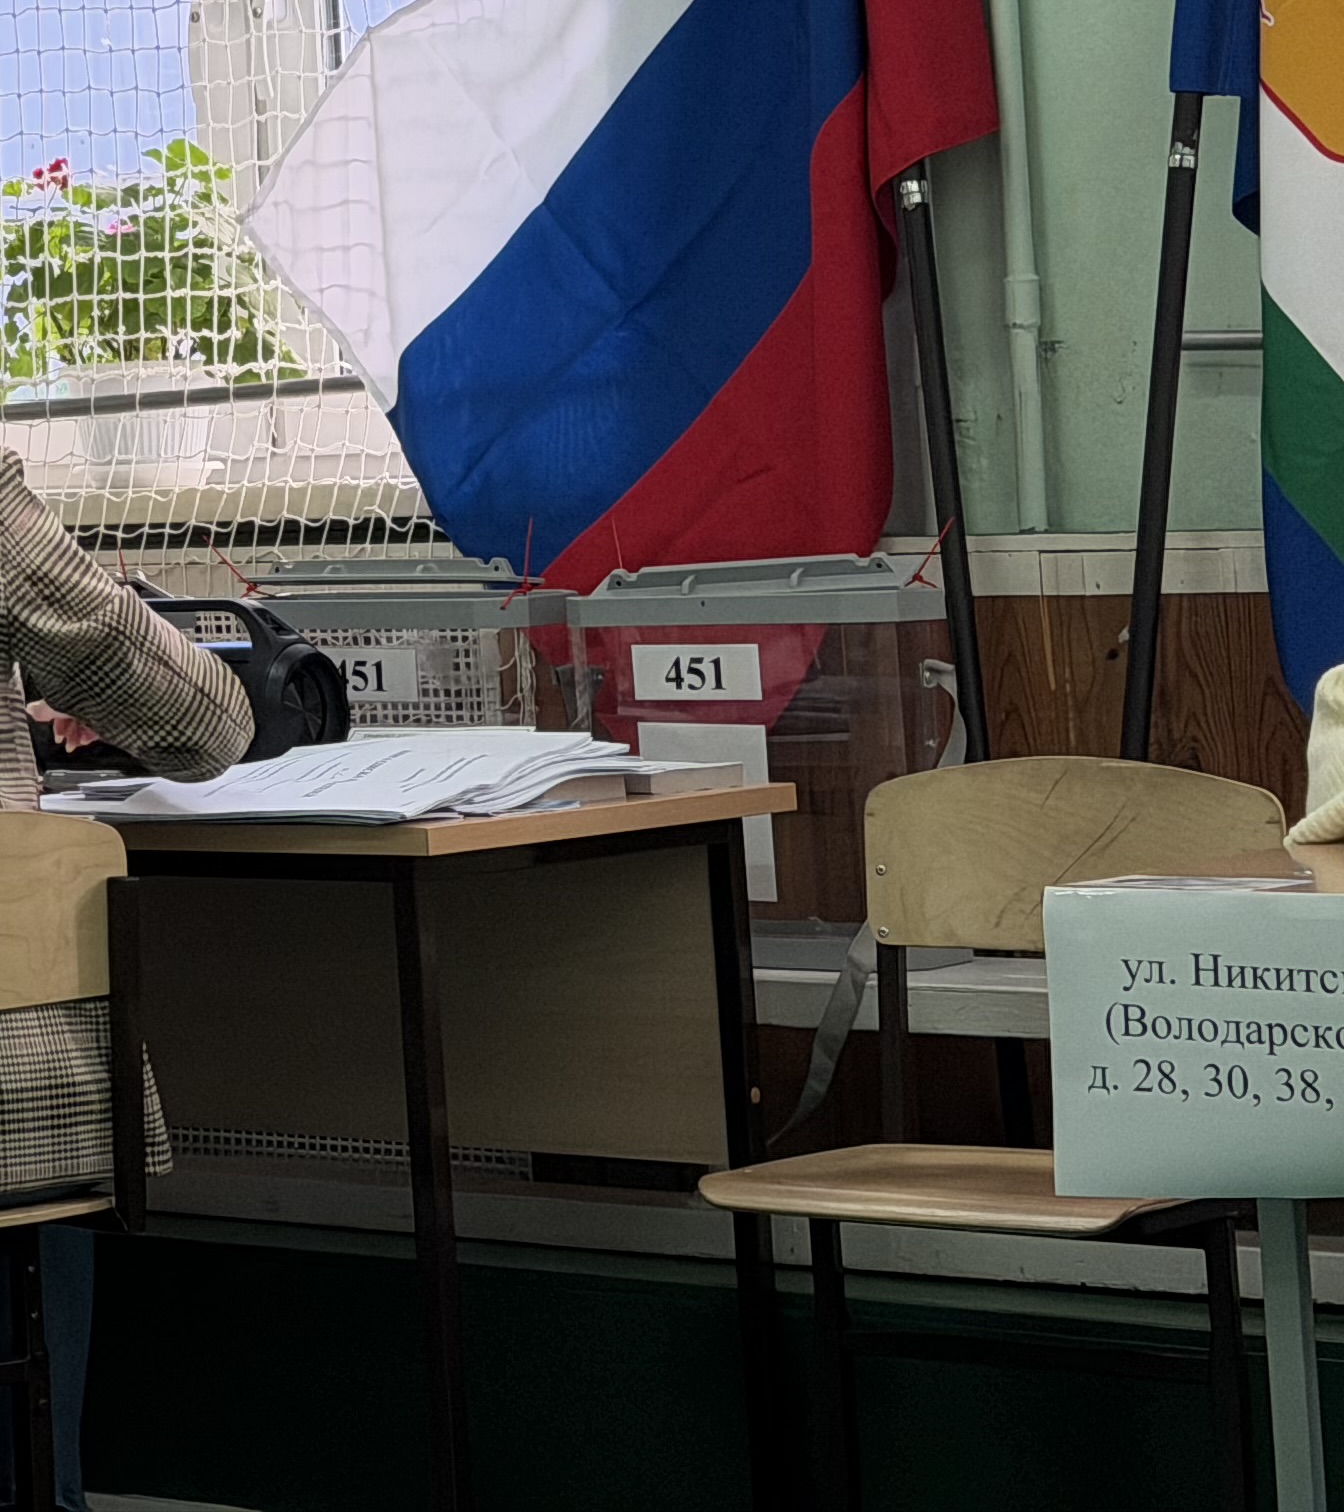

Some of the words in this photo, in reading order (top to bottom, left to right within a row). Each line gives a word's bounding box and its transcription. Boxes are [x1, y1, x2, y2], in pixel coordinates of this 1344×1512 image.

[665, 656, 726, 691] 451
[1120, 958, 1176, 991] ул.
[1190, 952, 1344, 994] Никитс
[1088, 1065, 1119, 1096] д.
[1132, 1058, 1190, 1102] 28,
[1203, 1063, 1262, 1107] 30,
[1274, 1068, 1334, 1112] 38,
